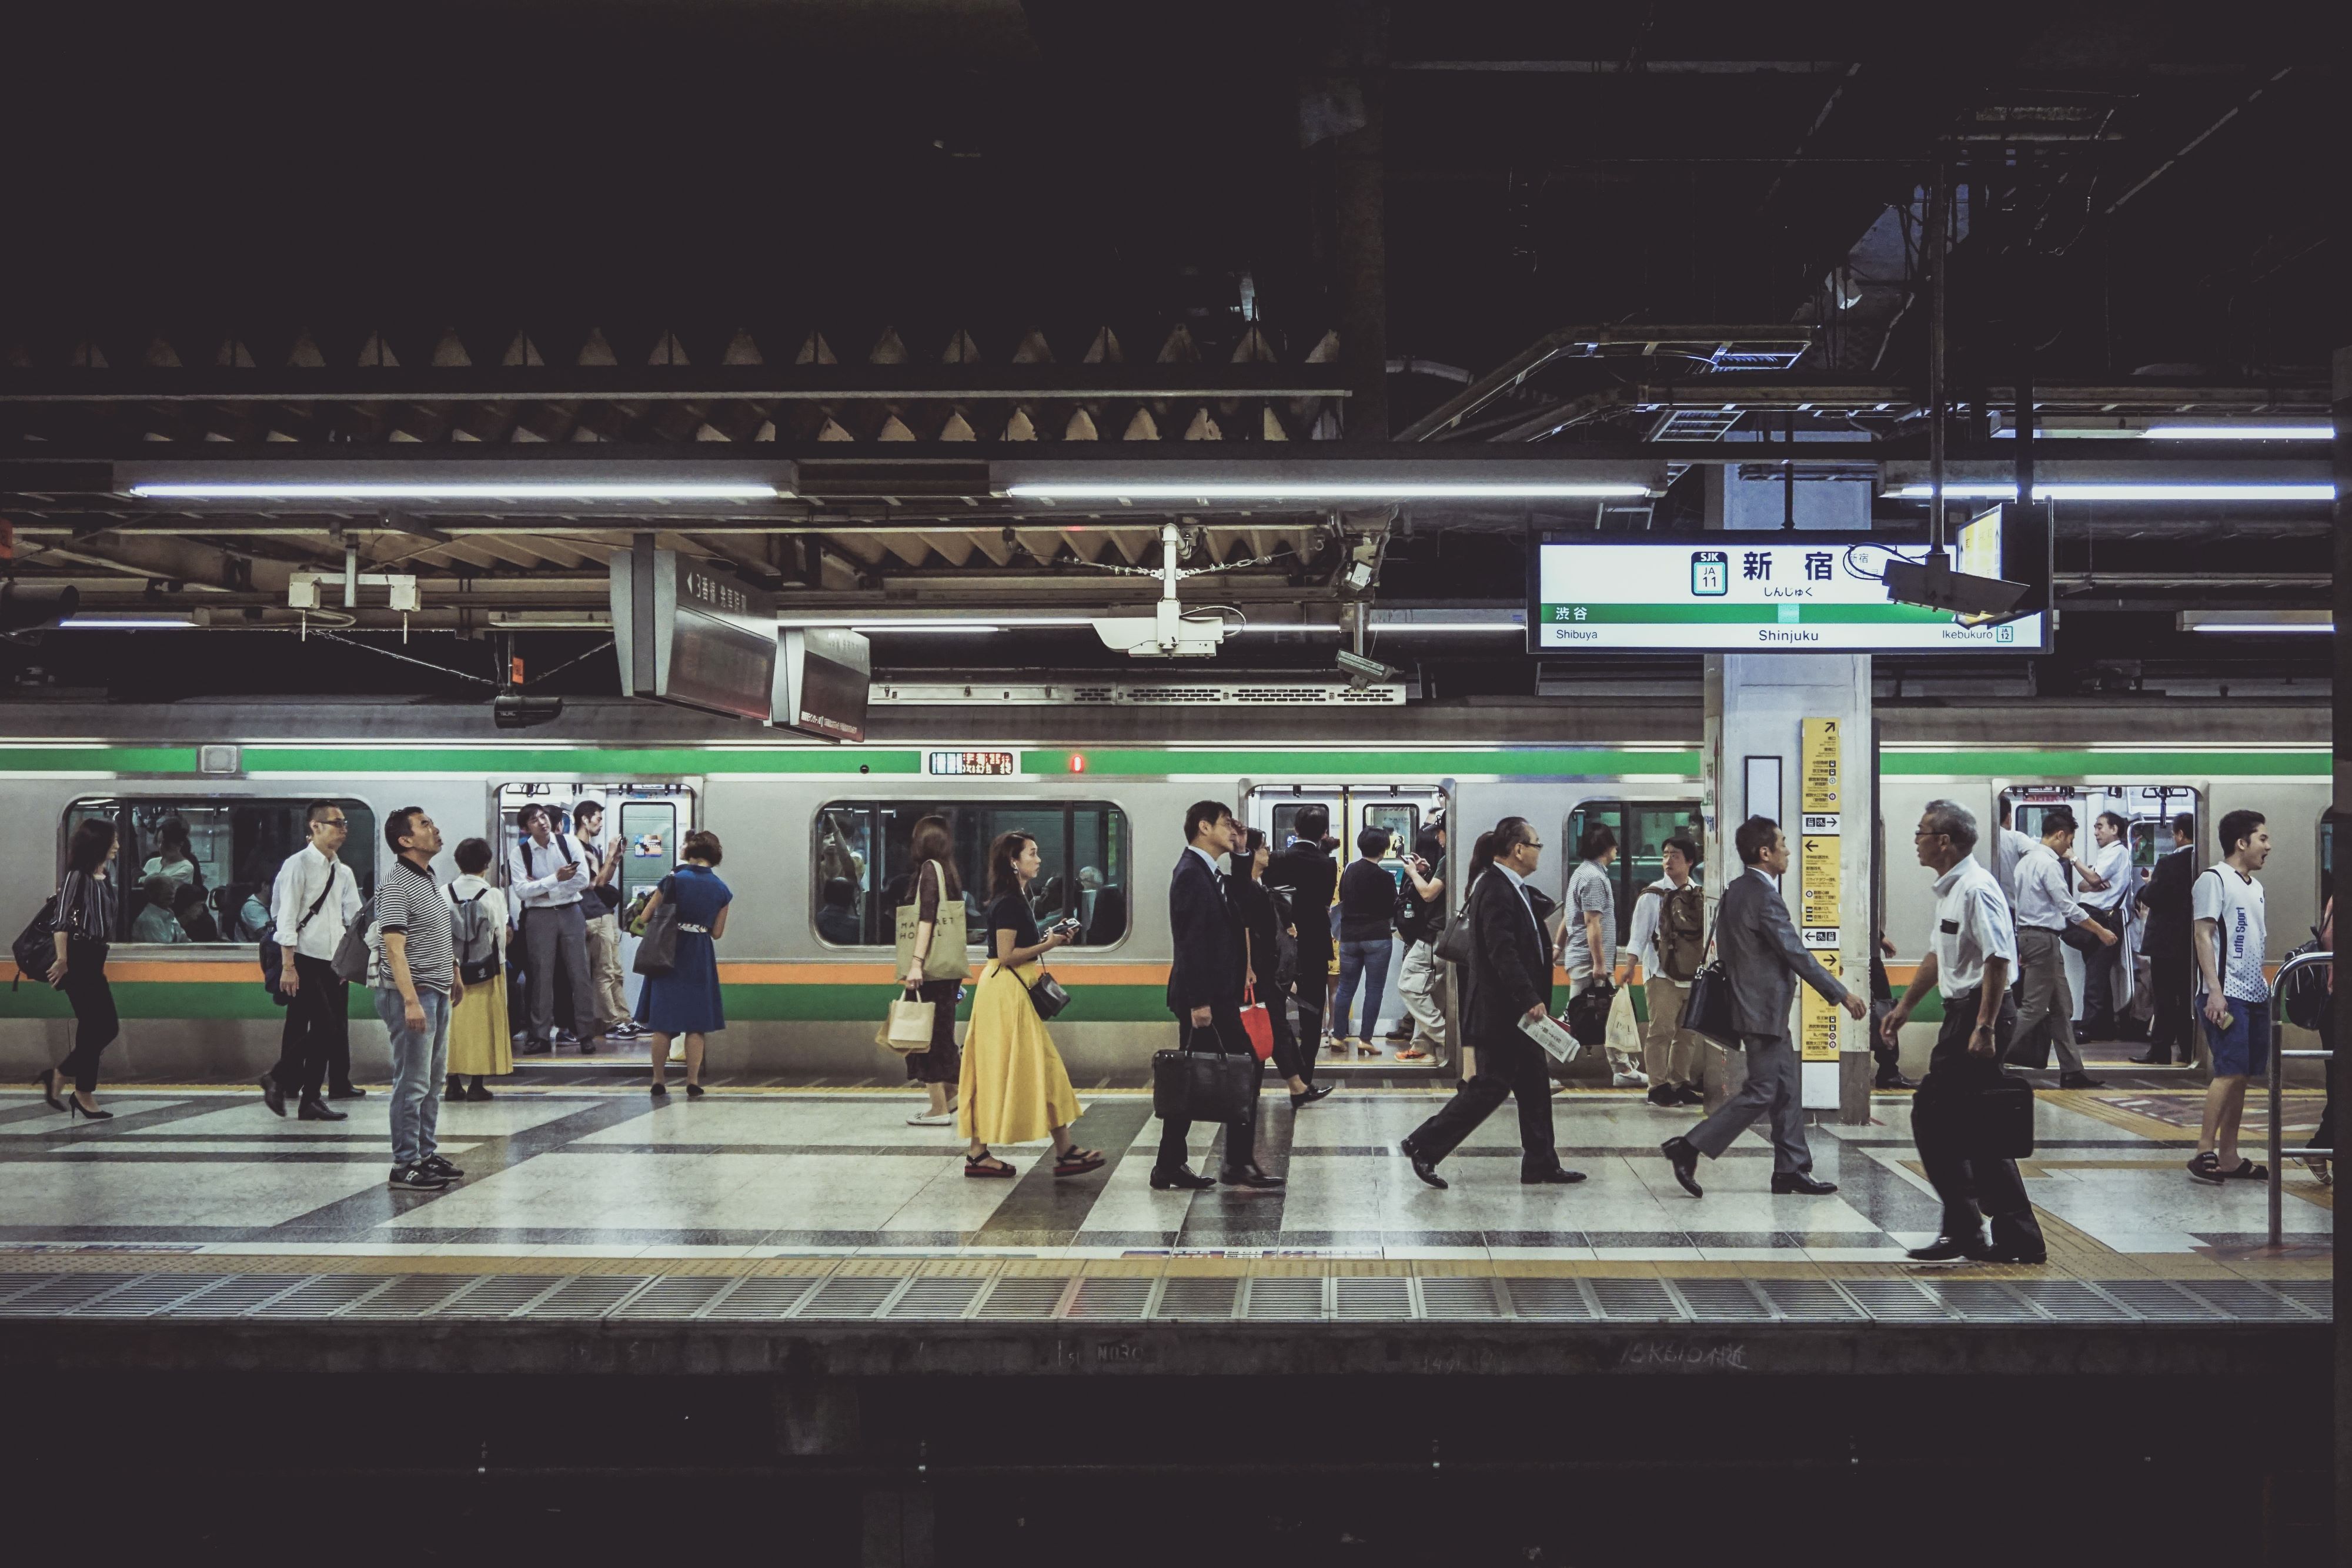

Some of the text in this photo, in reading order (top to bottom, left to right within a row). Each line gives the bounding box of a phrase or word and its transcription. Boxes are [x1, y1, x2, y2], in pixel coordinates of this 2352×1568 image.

[1700, 553, 1719, 561] SJK
[1703, 567, 1715, 575] JA
[1743, 551, 1833, 581] 新宿
[1702, 576, 1716, 587] 11
[1764, 587, 1813, 597] しんじゅく
[1556, 607, 1588, 621] 渋谷
[1556, 629, 1598, 641] Shibuya
[1759, 630, 1819, 644] Shinjuku
[1942, 630, 1993, 639] Ikebukuro
[901, 917, 953, 928] MARET
[900, 930, 942, 940] HOL
[2233, 907, 2248, 959] Lotto Sport
